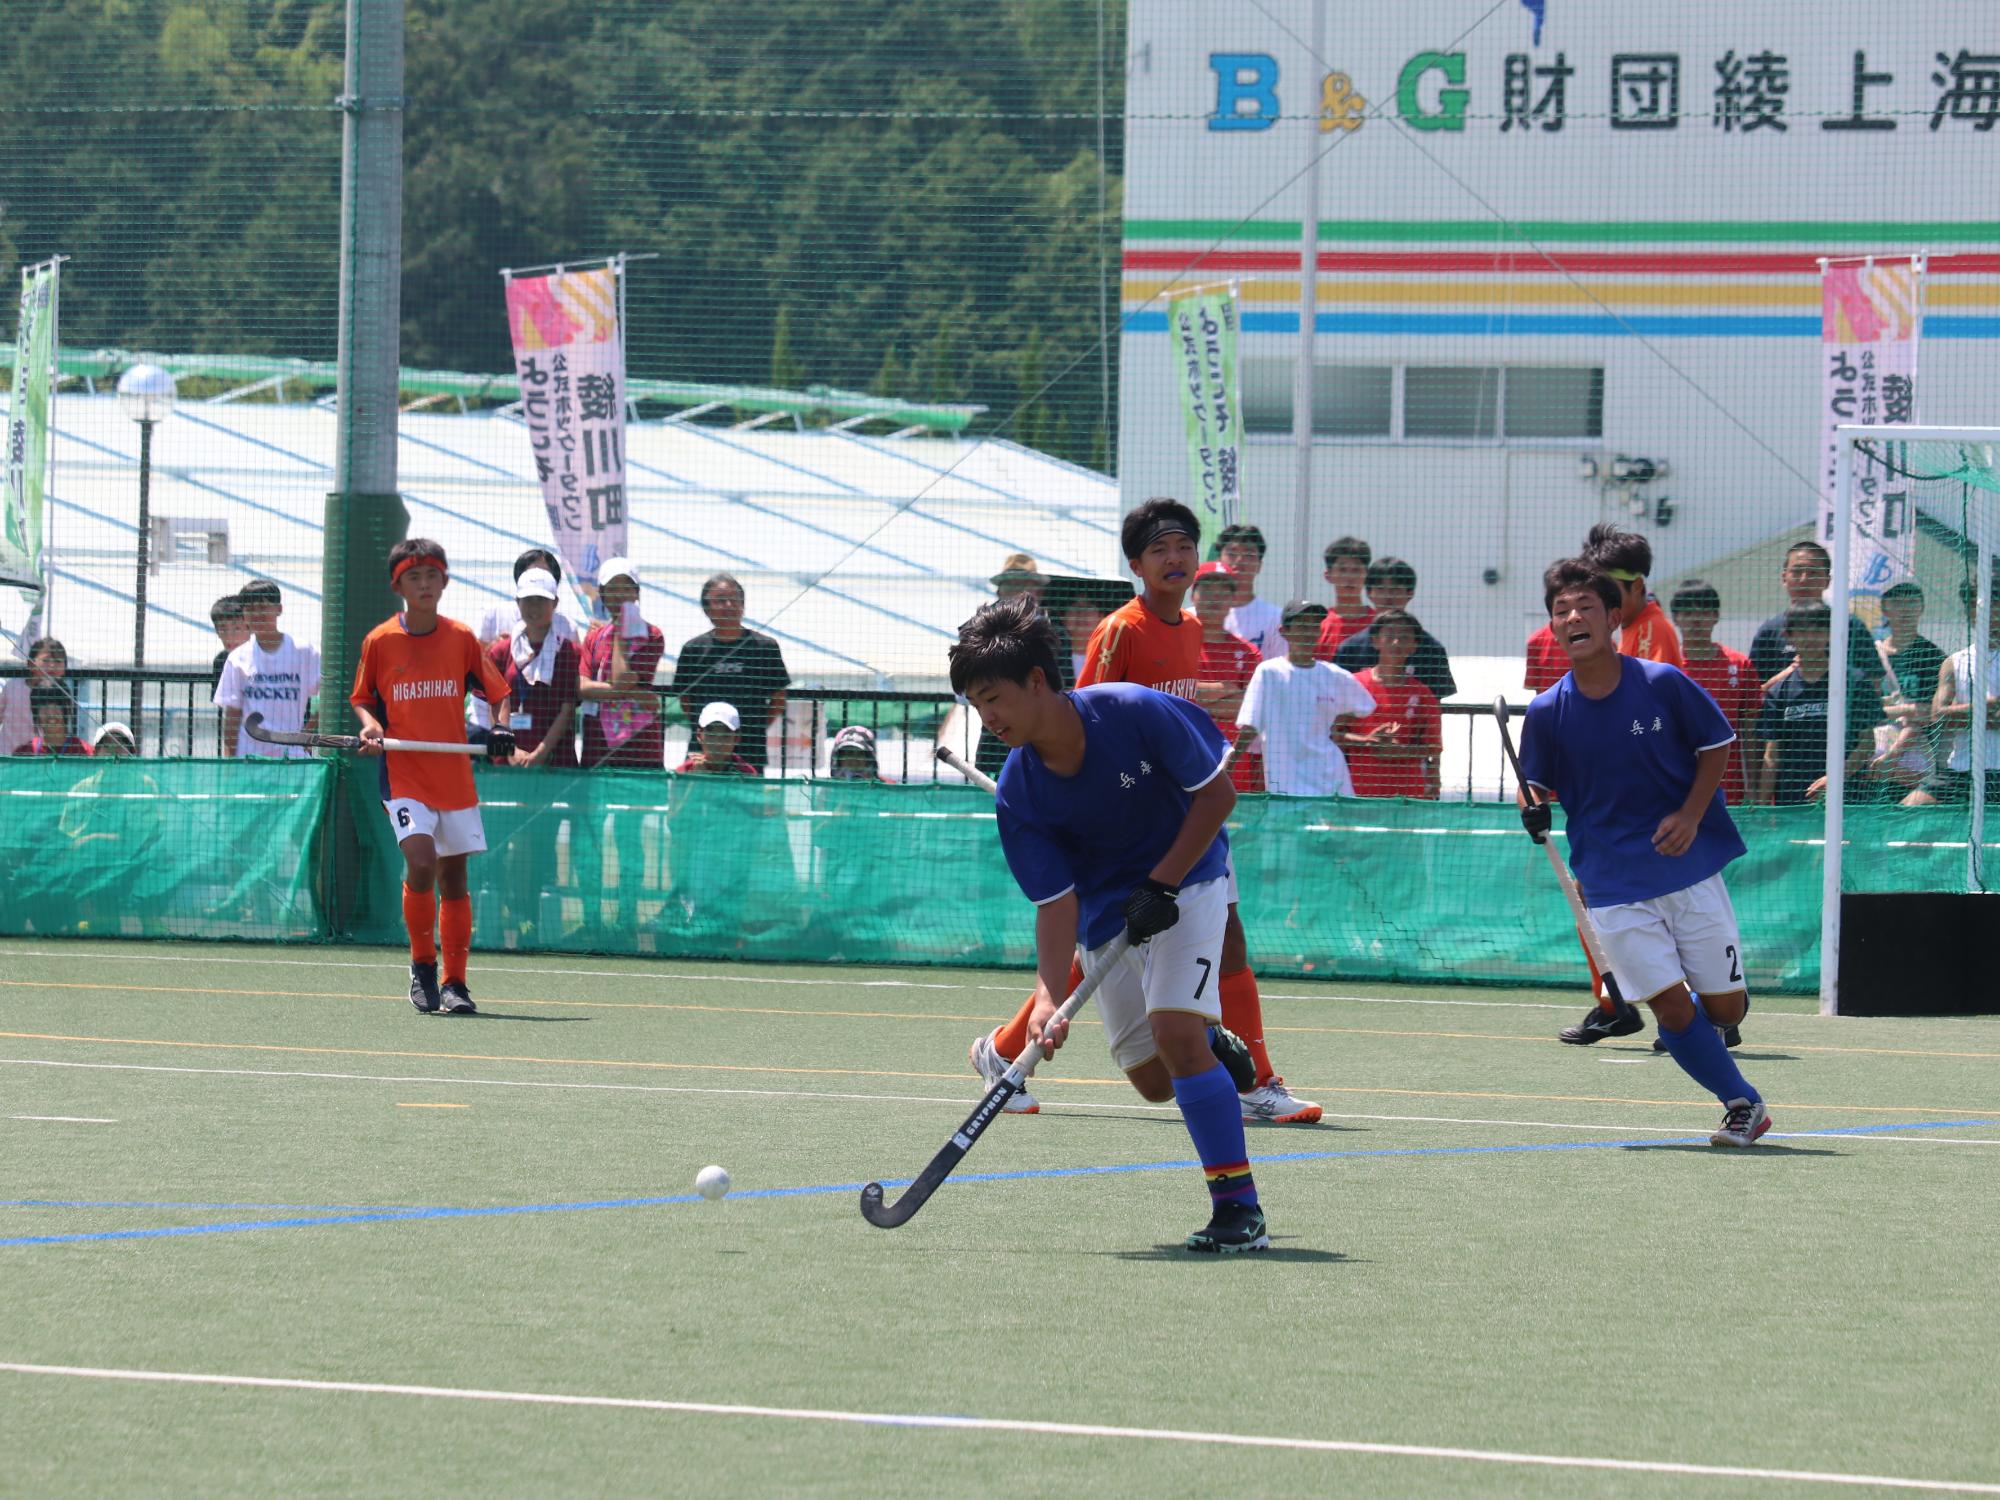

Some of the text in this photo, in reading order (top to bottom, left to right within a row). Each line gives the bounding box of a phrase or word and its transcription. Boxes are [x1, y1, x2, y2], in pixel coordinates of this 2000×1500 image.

[392, 679, 459, 702] HIGASHIHARA
[396, 807, 410, 828] 6
[1195, 957, 1212, 1000] 7
[1725, 945, 1742, 983] 2
